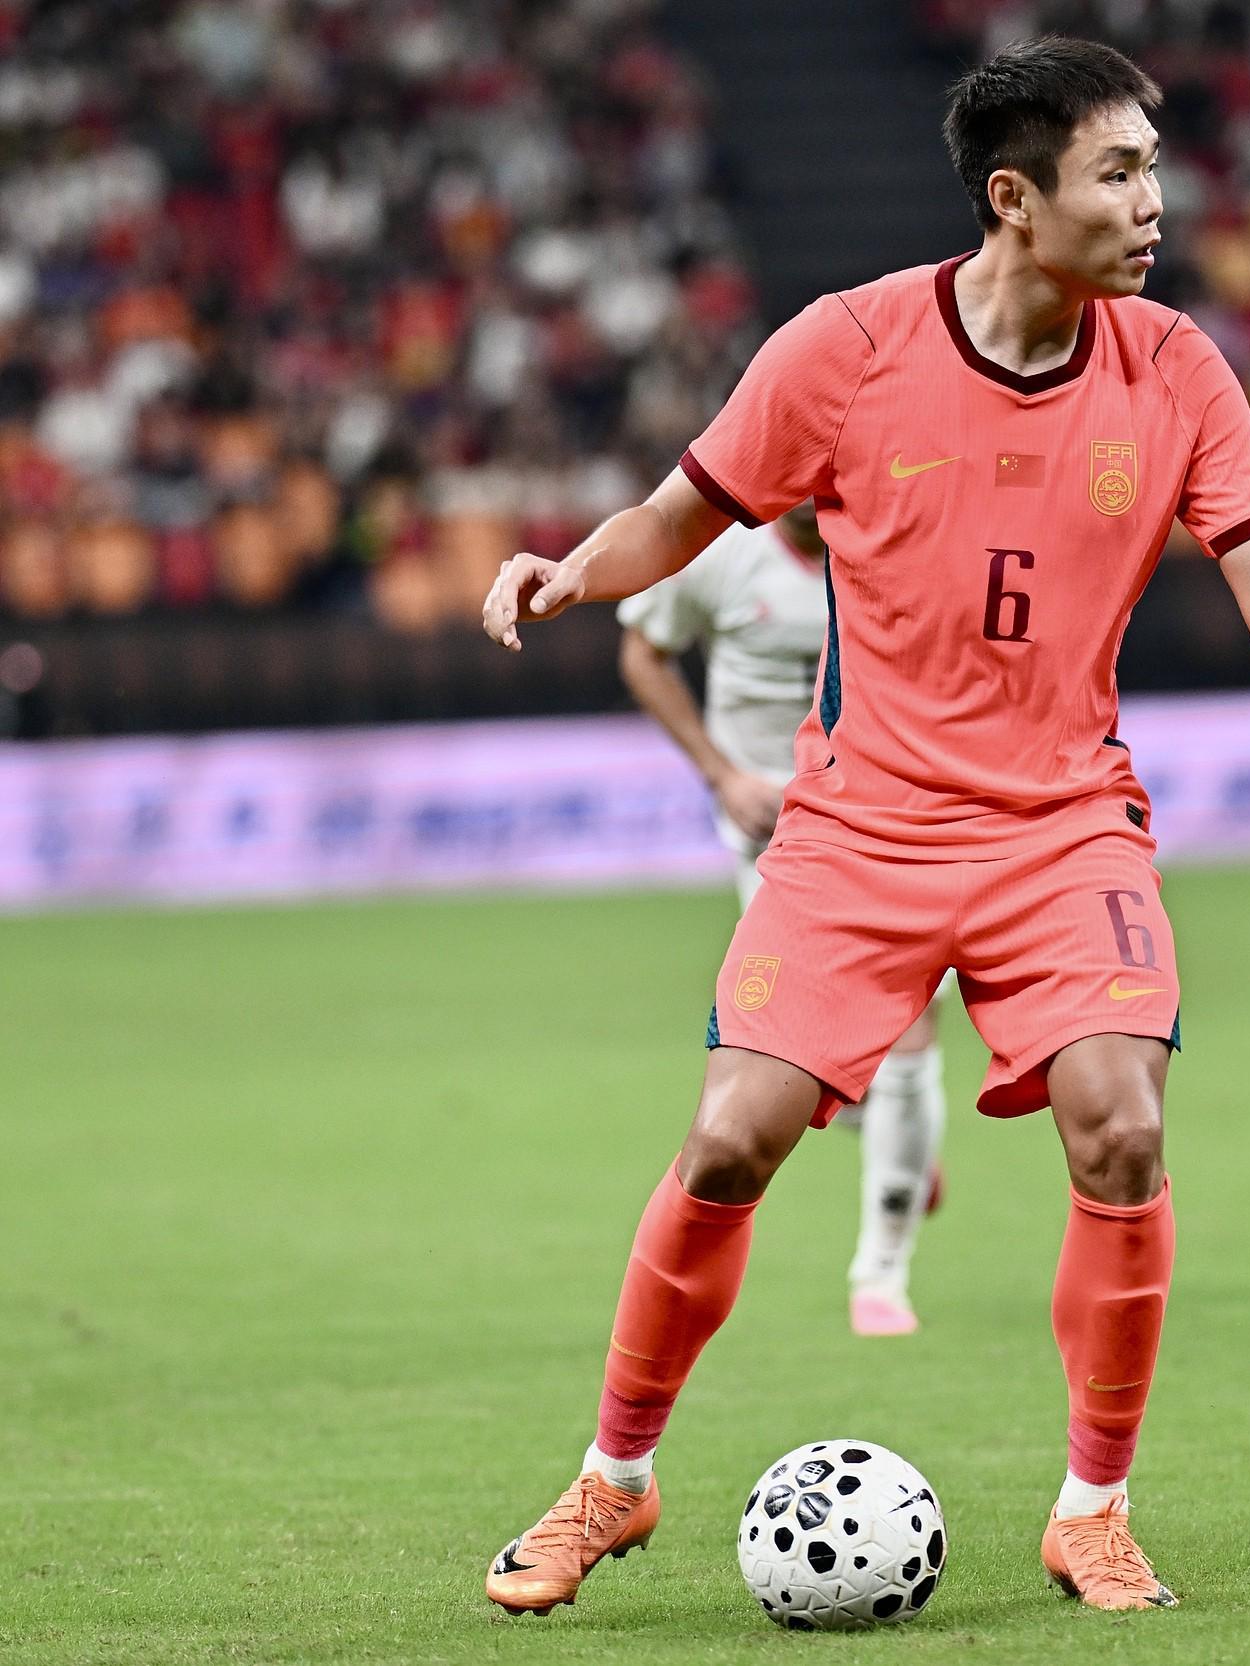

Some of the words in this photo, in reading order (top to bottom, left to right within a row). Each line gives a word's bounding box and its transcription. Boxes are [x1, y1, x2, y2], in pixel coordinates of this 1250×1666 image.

[1095, 445, 1133, 459] CFA
[983, 548, 1035, 643] 6
[1096, 890, 1162, 972] 6
[745, 959, 777, 970] CFA
